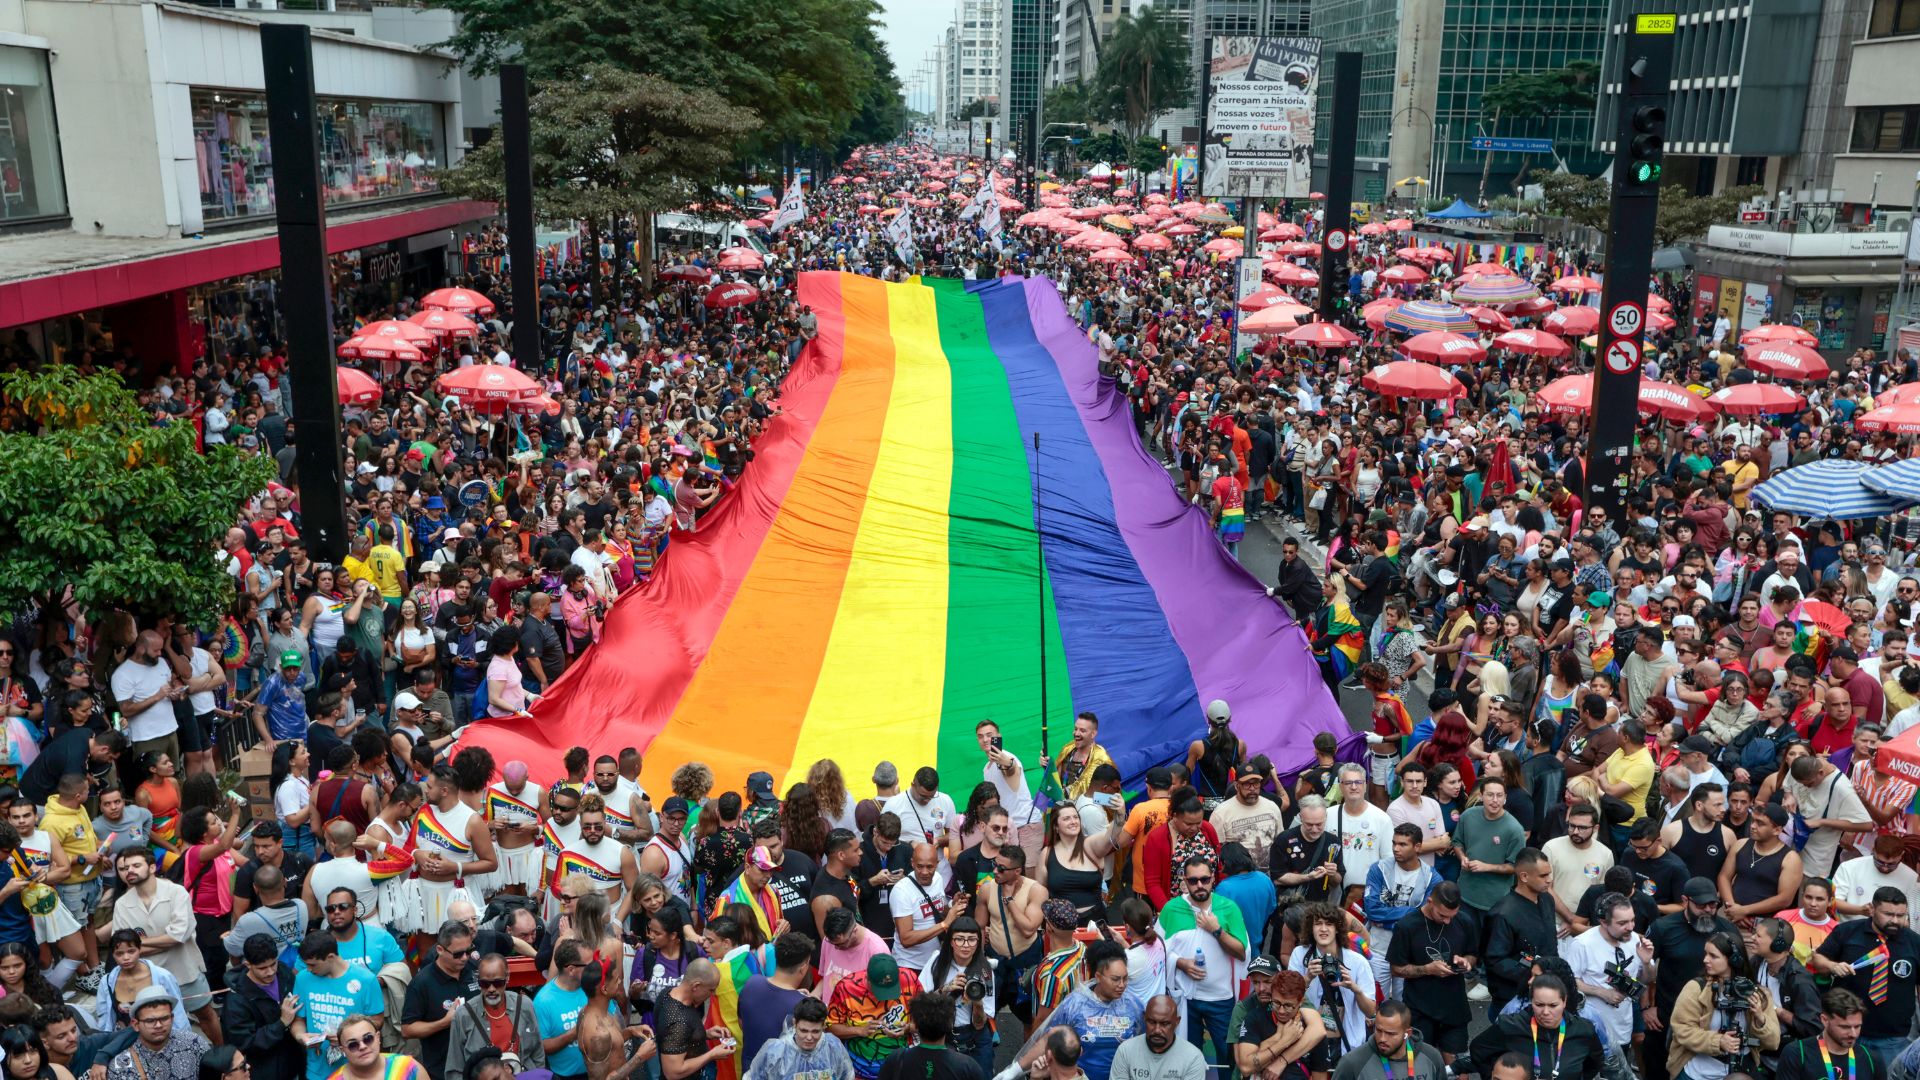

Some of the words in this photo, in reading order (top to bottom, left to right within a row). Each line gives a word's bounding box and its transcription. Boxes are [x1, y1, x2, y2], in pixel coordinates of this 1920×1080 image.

[1648, 20, 1672, 28] 2825
[1260, 42, 1276, 57] do
[1278, 48, 1308, 63] povo
[1271, 96, 1307, 106] história,
[370, 251, 400, 284] marisa
[722, 288, 750, 300] BRAHMA
[1615, 310, 1638, 325] 50
[1759, 350, 1801, 368] BRAHMA
[1641, 387, 1689, 408] BRAHMA
[1556, 405, 1576, 413] AMSTEL
[377, 560, 383, 579] 9
[781, 898, 808, 910] RAGEM
[309, 992, 355, 1006] POLÍTICA&
[310, 1002, 346, 1015] GARRA&
[1133, 1068, 1149, 1078] 169
